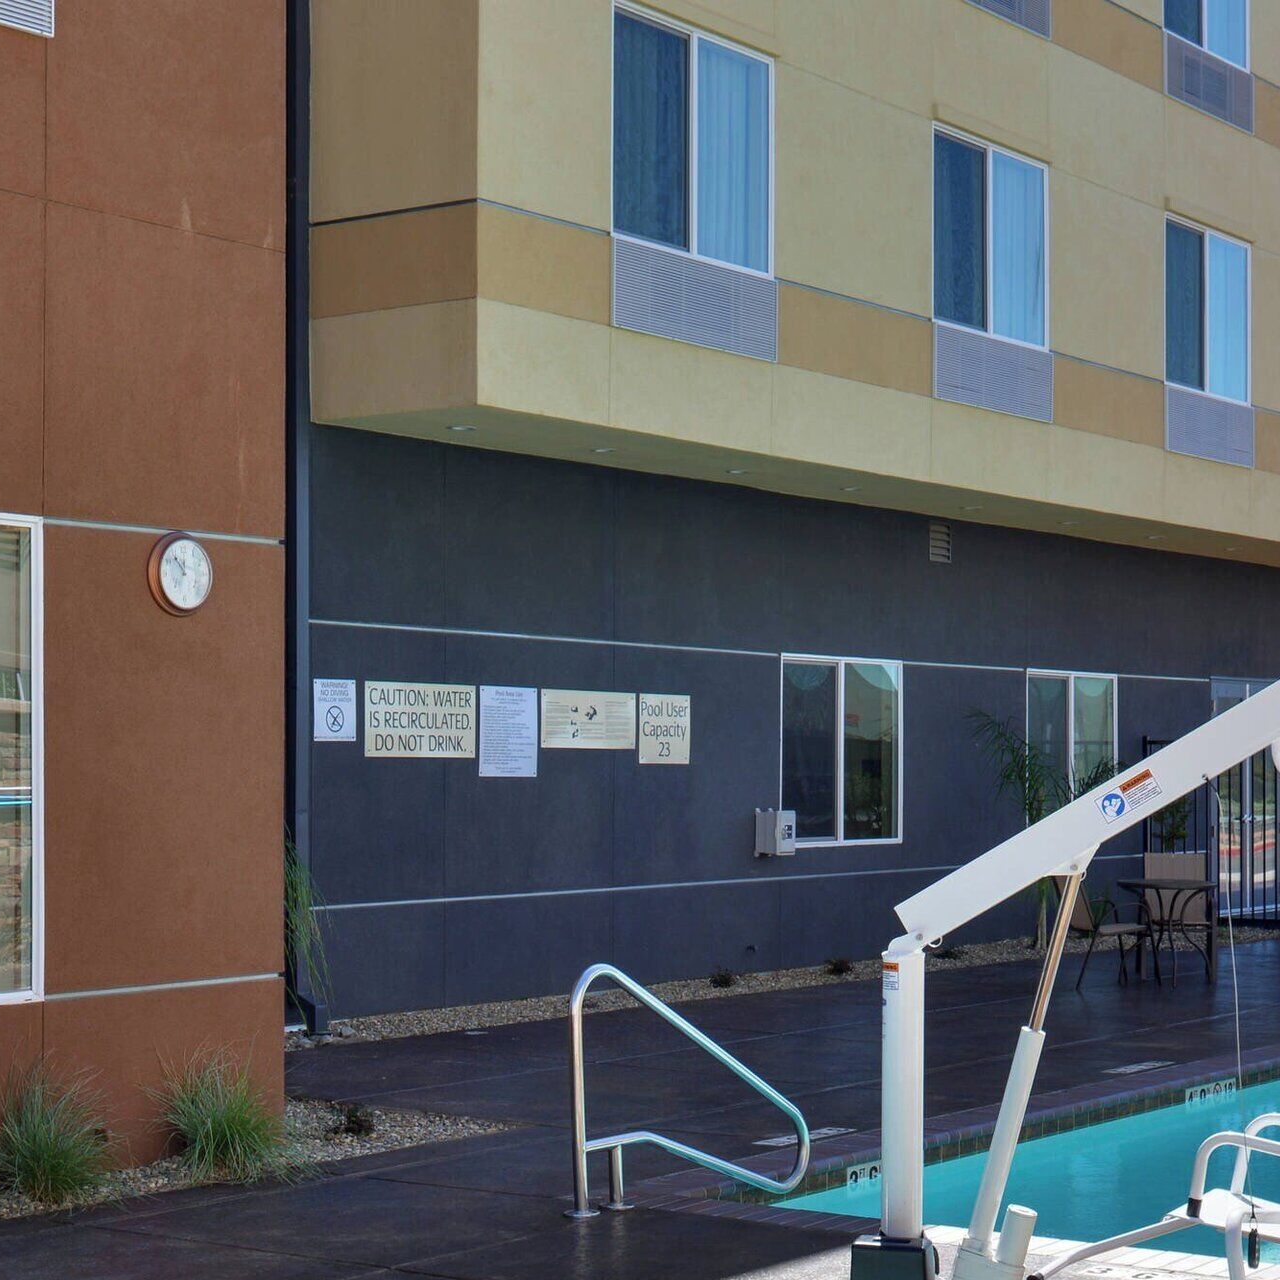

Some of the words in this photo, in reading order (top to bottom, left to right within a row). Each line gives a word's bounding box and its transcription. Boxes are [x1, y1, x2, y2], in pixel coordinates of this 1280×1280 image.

[369, 688, 429, 706] CAUTION:
[433, 690, 472, 707] WATER
[641, 701, 663, 717] Pool
[667, 702, 688, 717] User
[369, 711, 380, 728] IS
[384, 711, 472, 730] RECIRCULATED.
[642, 721, 687, 742] Capacity
[375, 734, 394, 751] DO
[398, 734, 424, 751] NOT
[428, 735, 467, 752] DRINK.
[658, 742, 671, 757] 23
